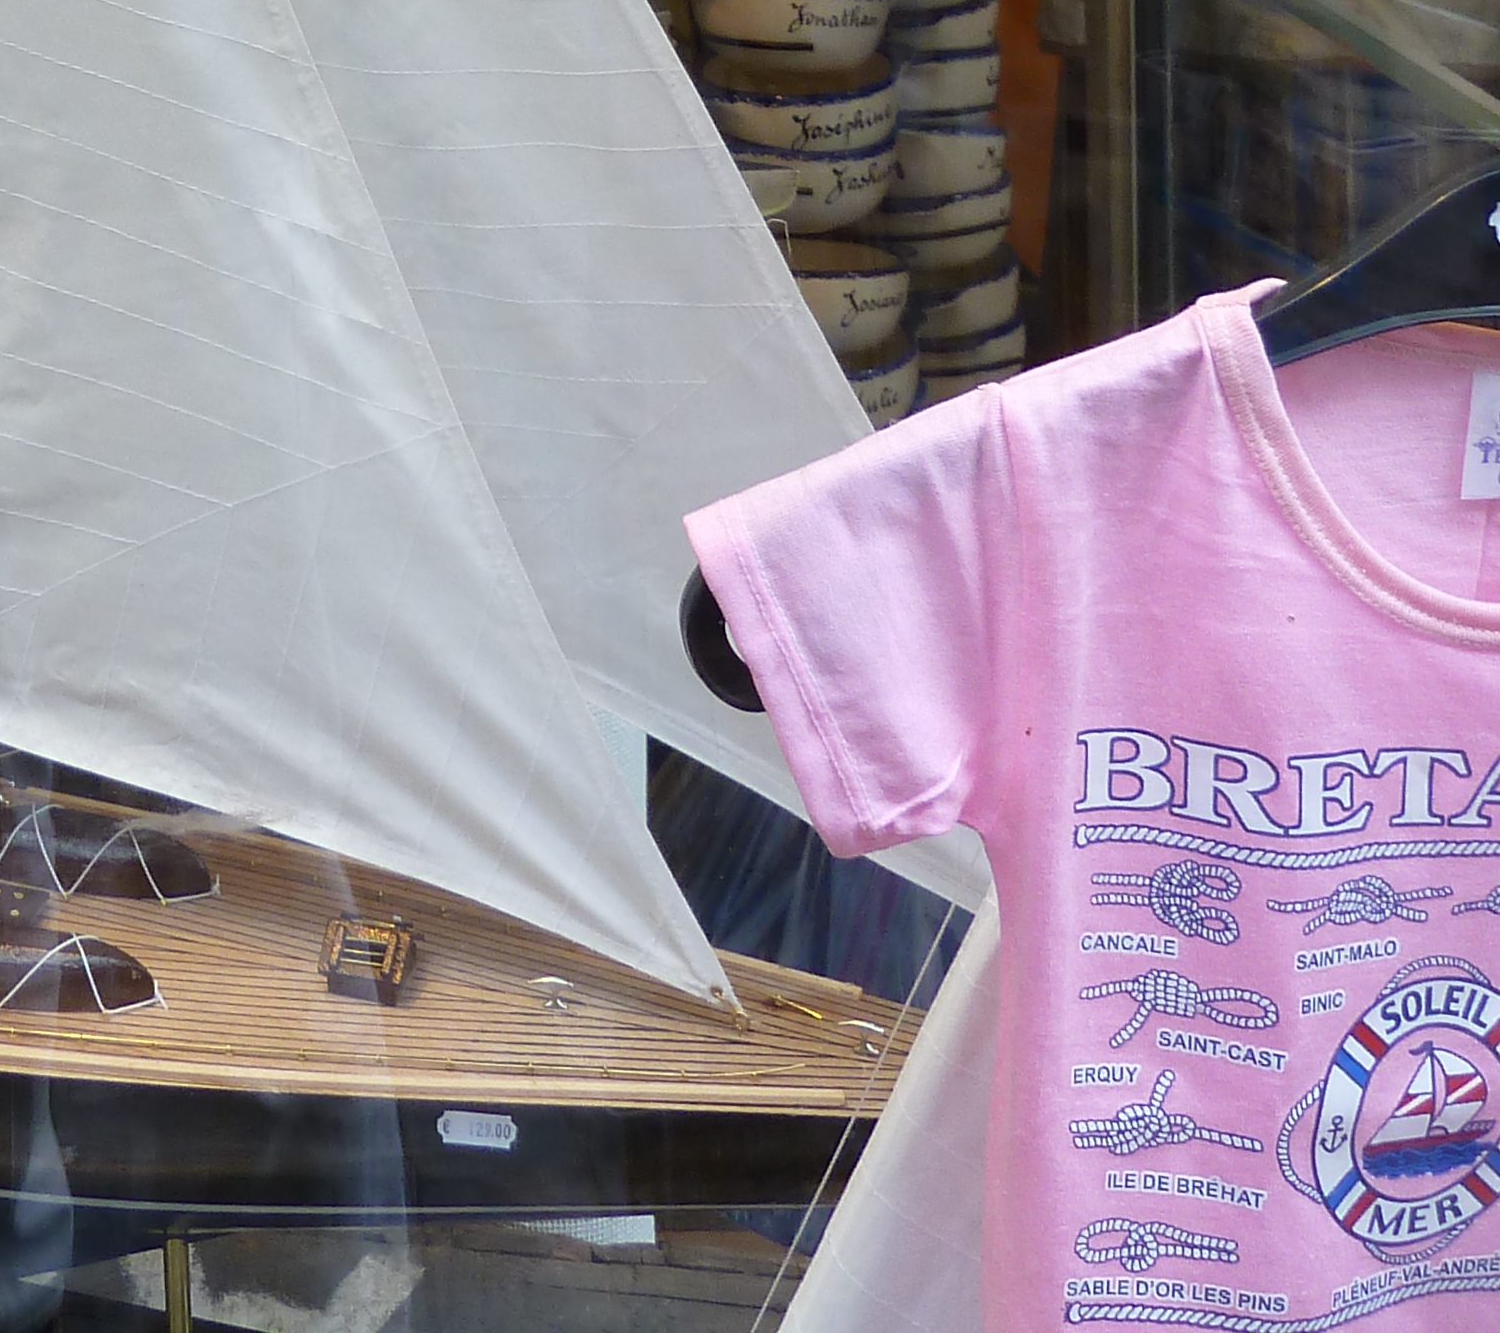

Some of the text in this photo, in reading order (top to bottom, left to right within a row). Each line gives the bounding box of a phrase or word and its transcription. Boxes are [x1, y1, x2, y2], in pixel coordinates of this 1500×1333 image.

[1080, 934, 1177, 956] CANCALE
[1296, 940, 1398, 970] SAINT-MALO
[1300, 993, 1344, 1015] BINIC
[1380, 984, 1490, 1035] SOLEIL
[1158, 1030, 1287, 1071] SAINT-CAST
[1073, 1066, 1138, 1084] ERQUY
[1107, 1173, 1265, 1209] ILE DE BRÉHAT
[1367, 1192, 1464, 1236] MER
[1066, 1279, 1287, 1313] SABLE D'OR LES PINS
